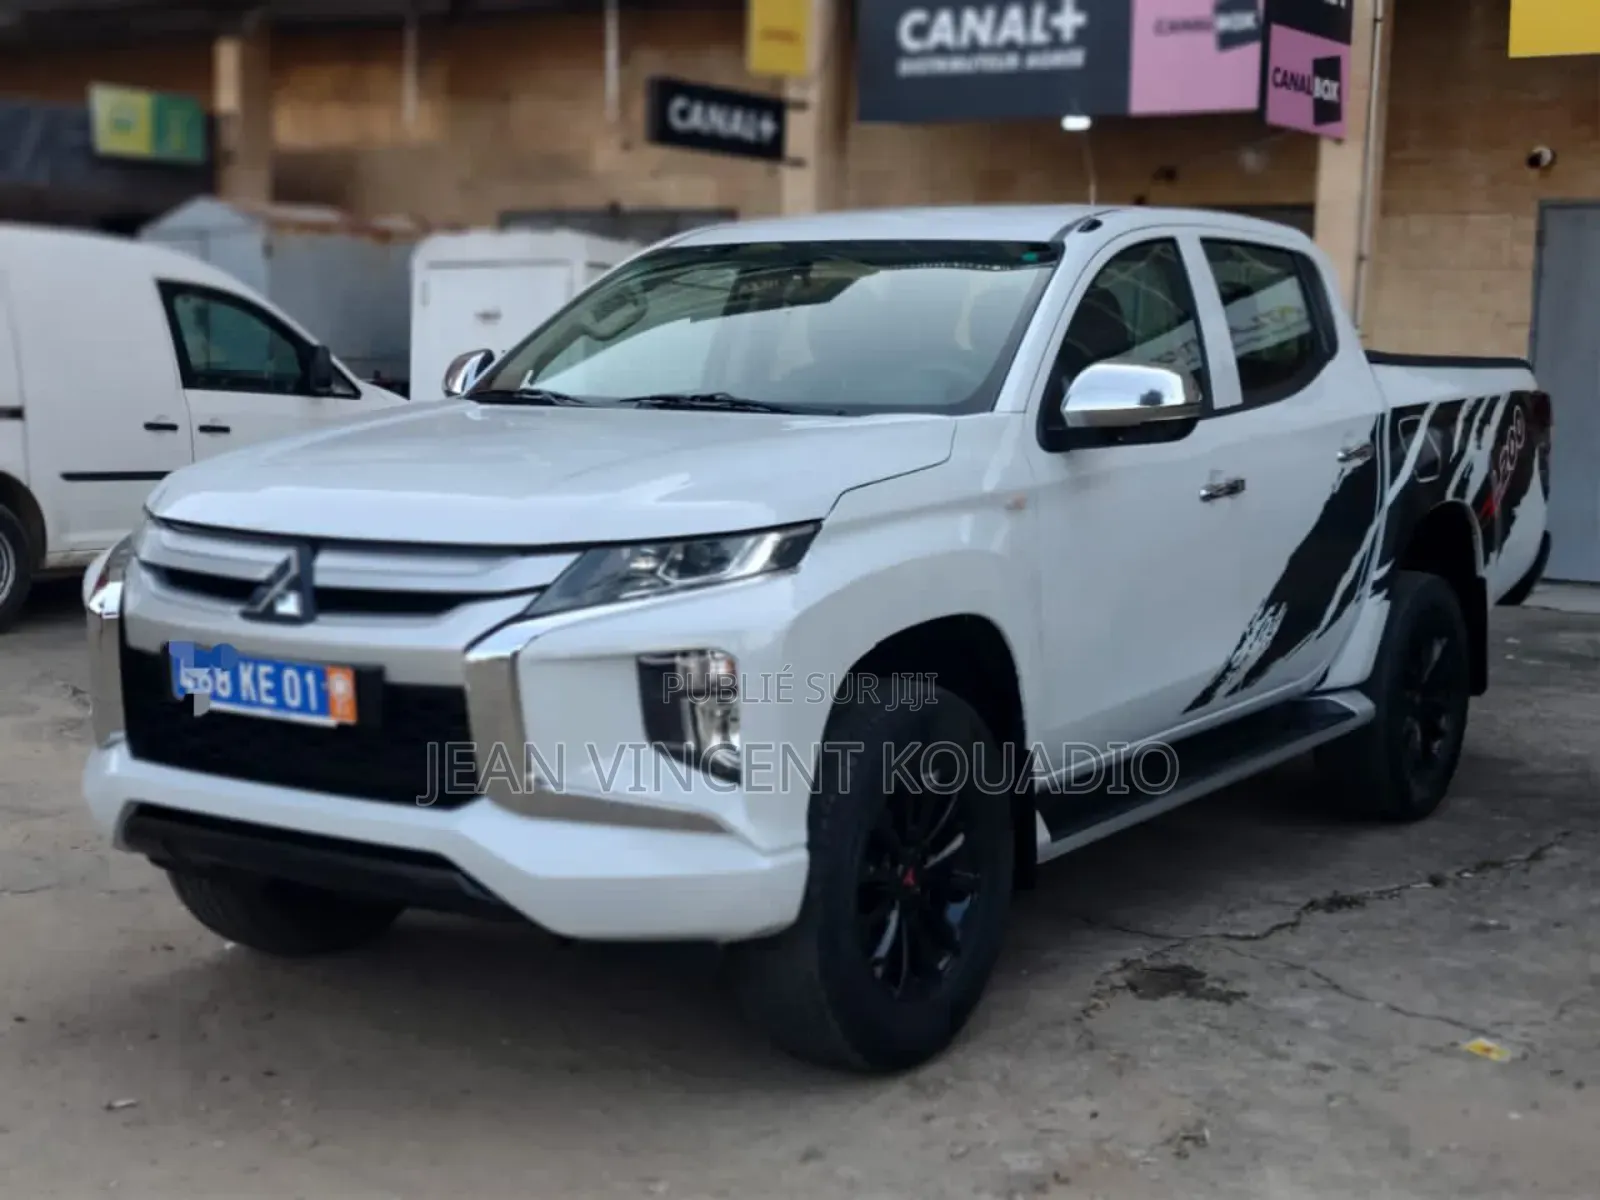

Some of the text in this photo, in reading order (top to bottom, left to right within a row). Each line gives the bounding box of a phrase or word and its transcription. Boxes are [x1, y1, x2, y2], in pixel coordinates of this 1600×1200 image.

[897, 0, 1087, 52] CANAL+
[667, 94, 777, 143] CANAL+
[239, 662, 276, 704] KE
[282, 669, 317, 712] 01
